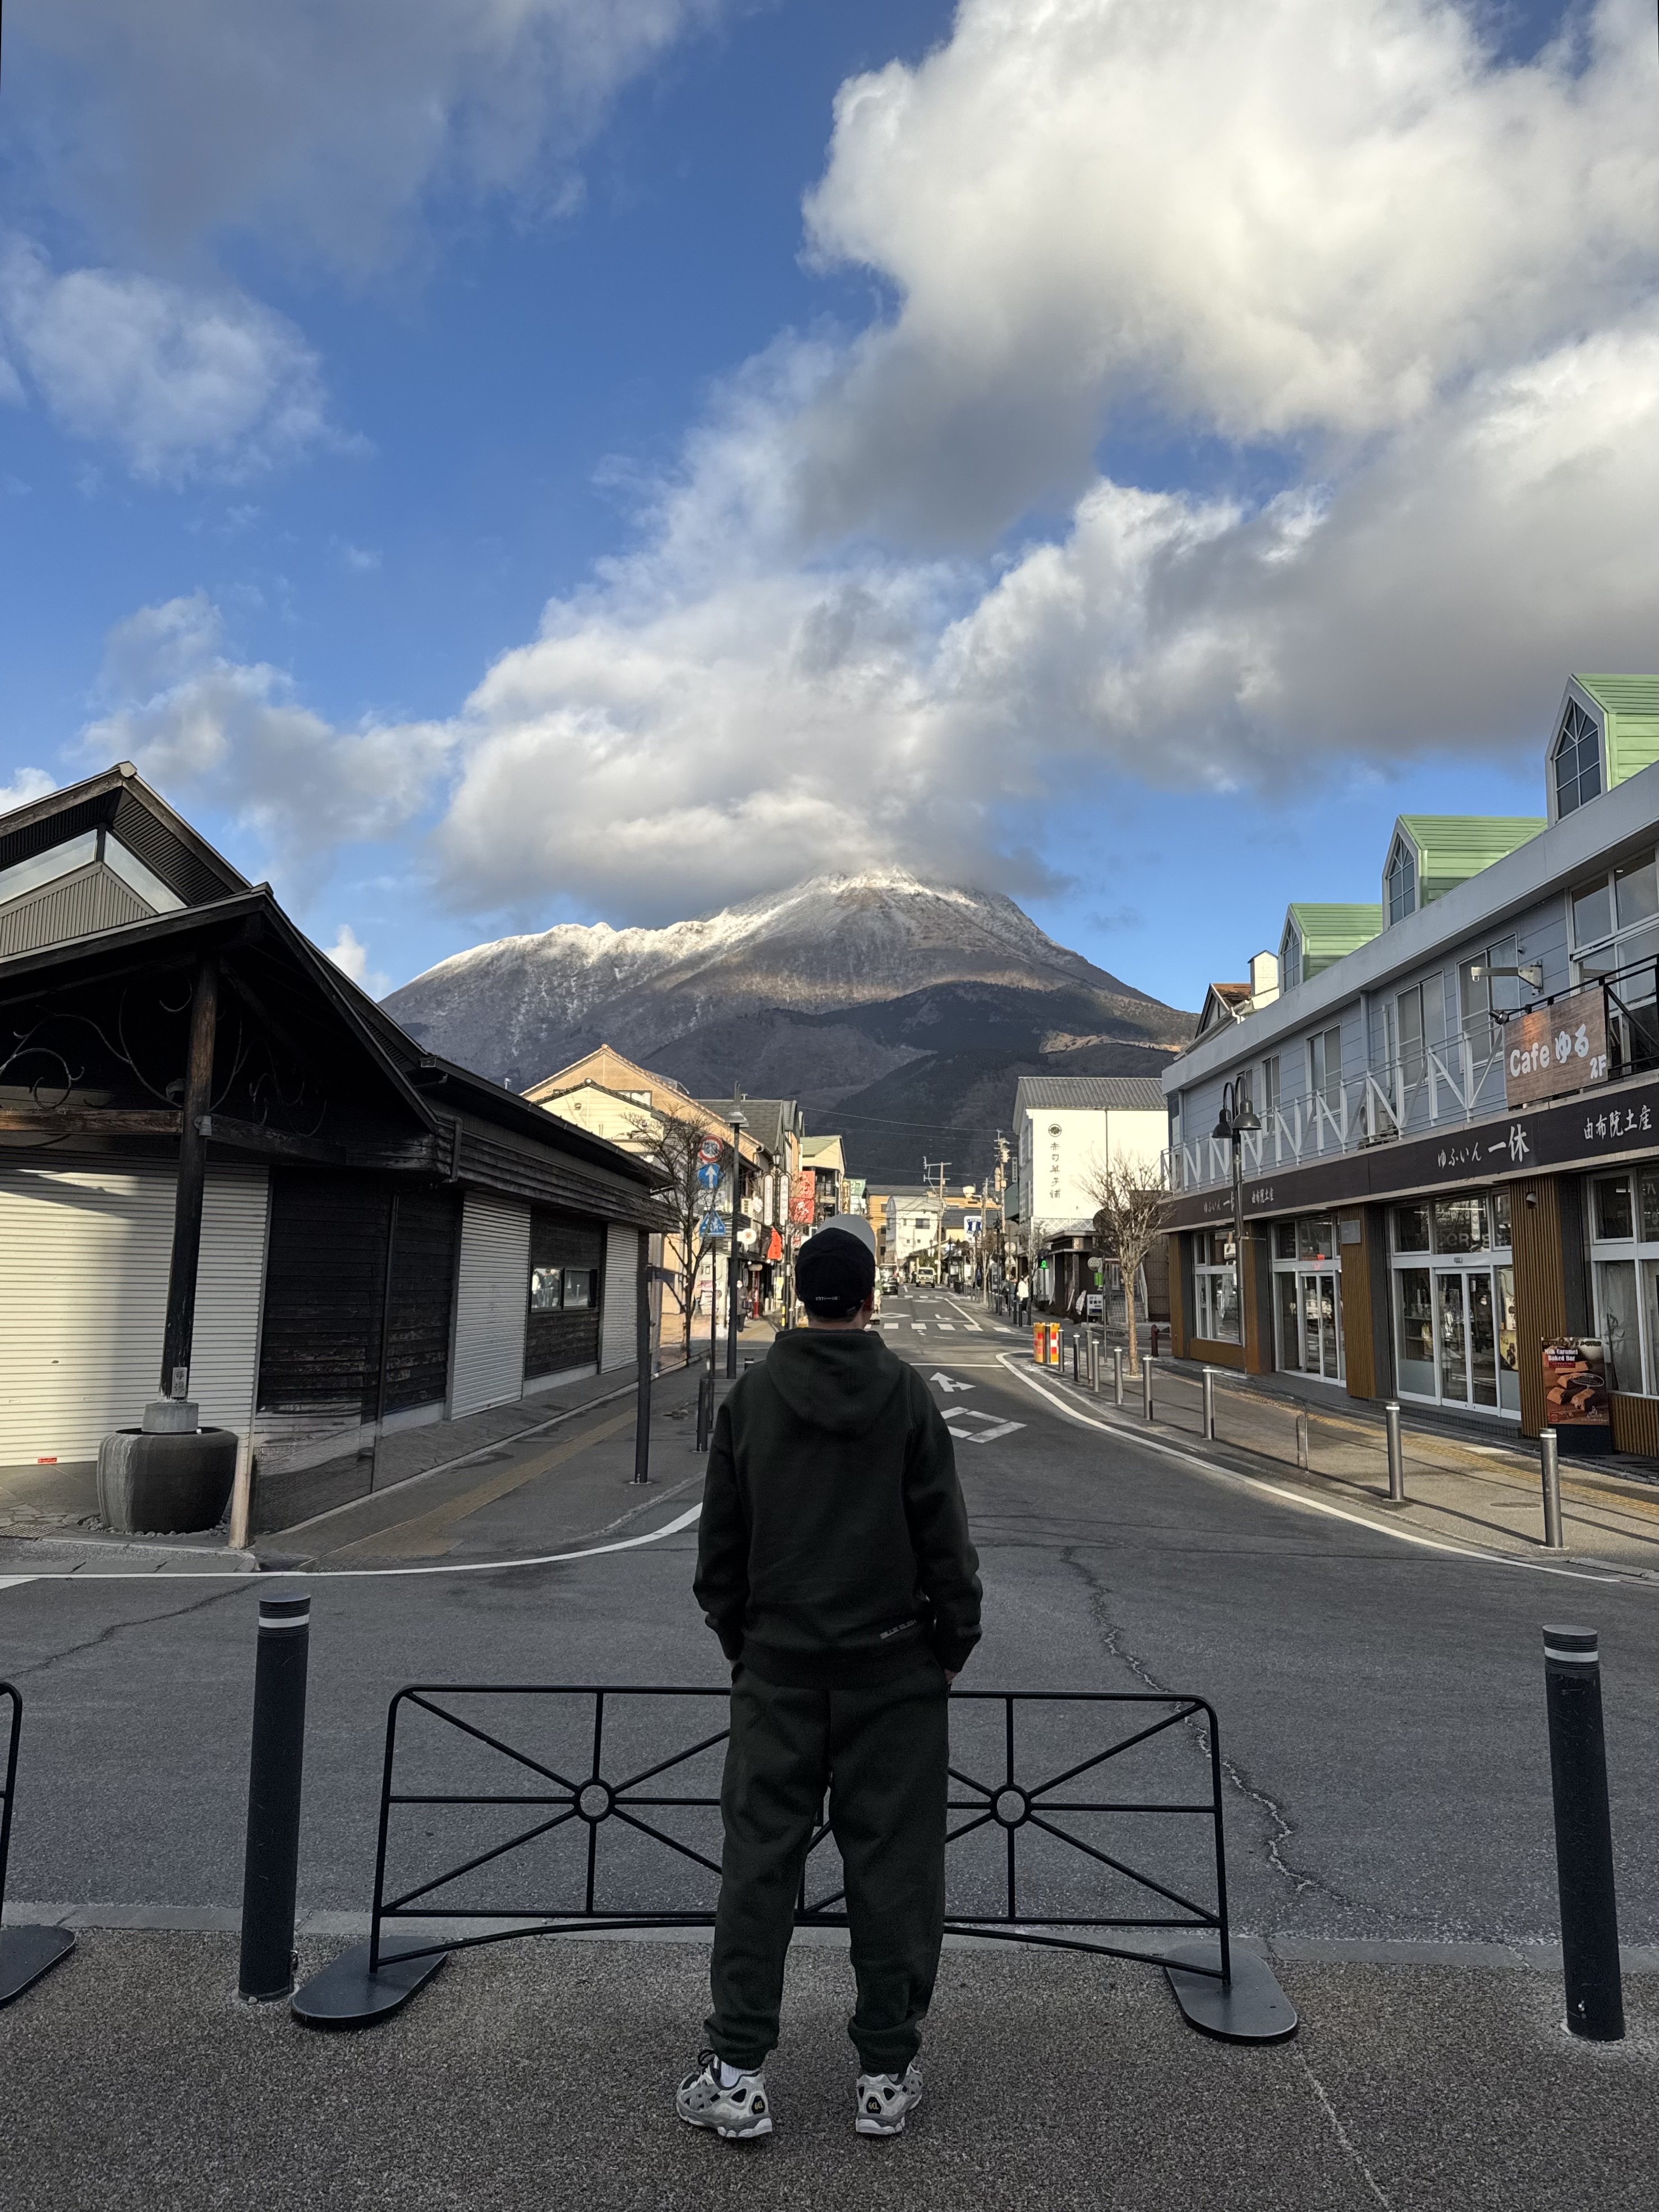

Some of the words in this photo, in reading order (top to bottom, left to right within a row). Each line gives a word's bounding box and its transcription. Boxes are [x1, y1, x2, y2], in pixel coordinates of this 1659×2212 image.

[1510, 1042, 1550, 1077] Cafe
[1555, 1023, 1589, 1064] ゆる
[1589, 1054, 1607, 1079] 2F
[1583, 1105, 1652, 1140] 由布院土産
[1437, 1142, 1482, 1169] ゆふいん
[1487, 1124, 1531, 1163] 一休
[1049, 1142, 1061, 1199] 赤司菓子舗
